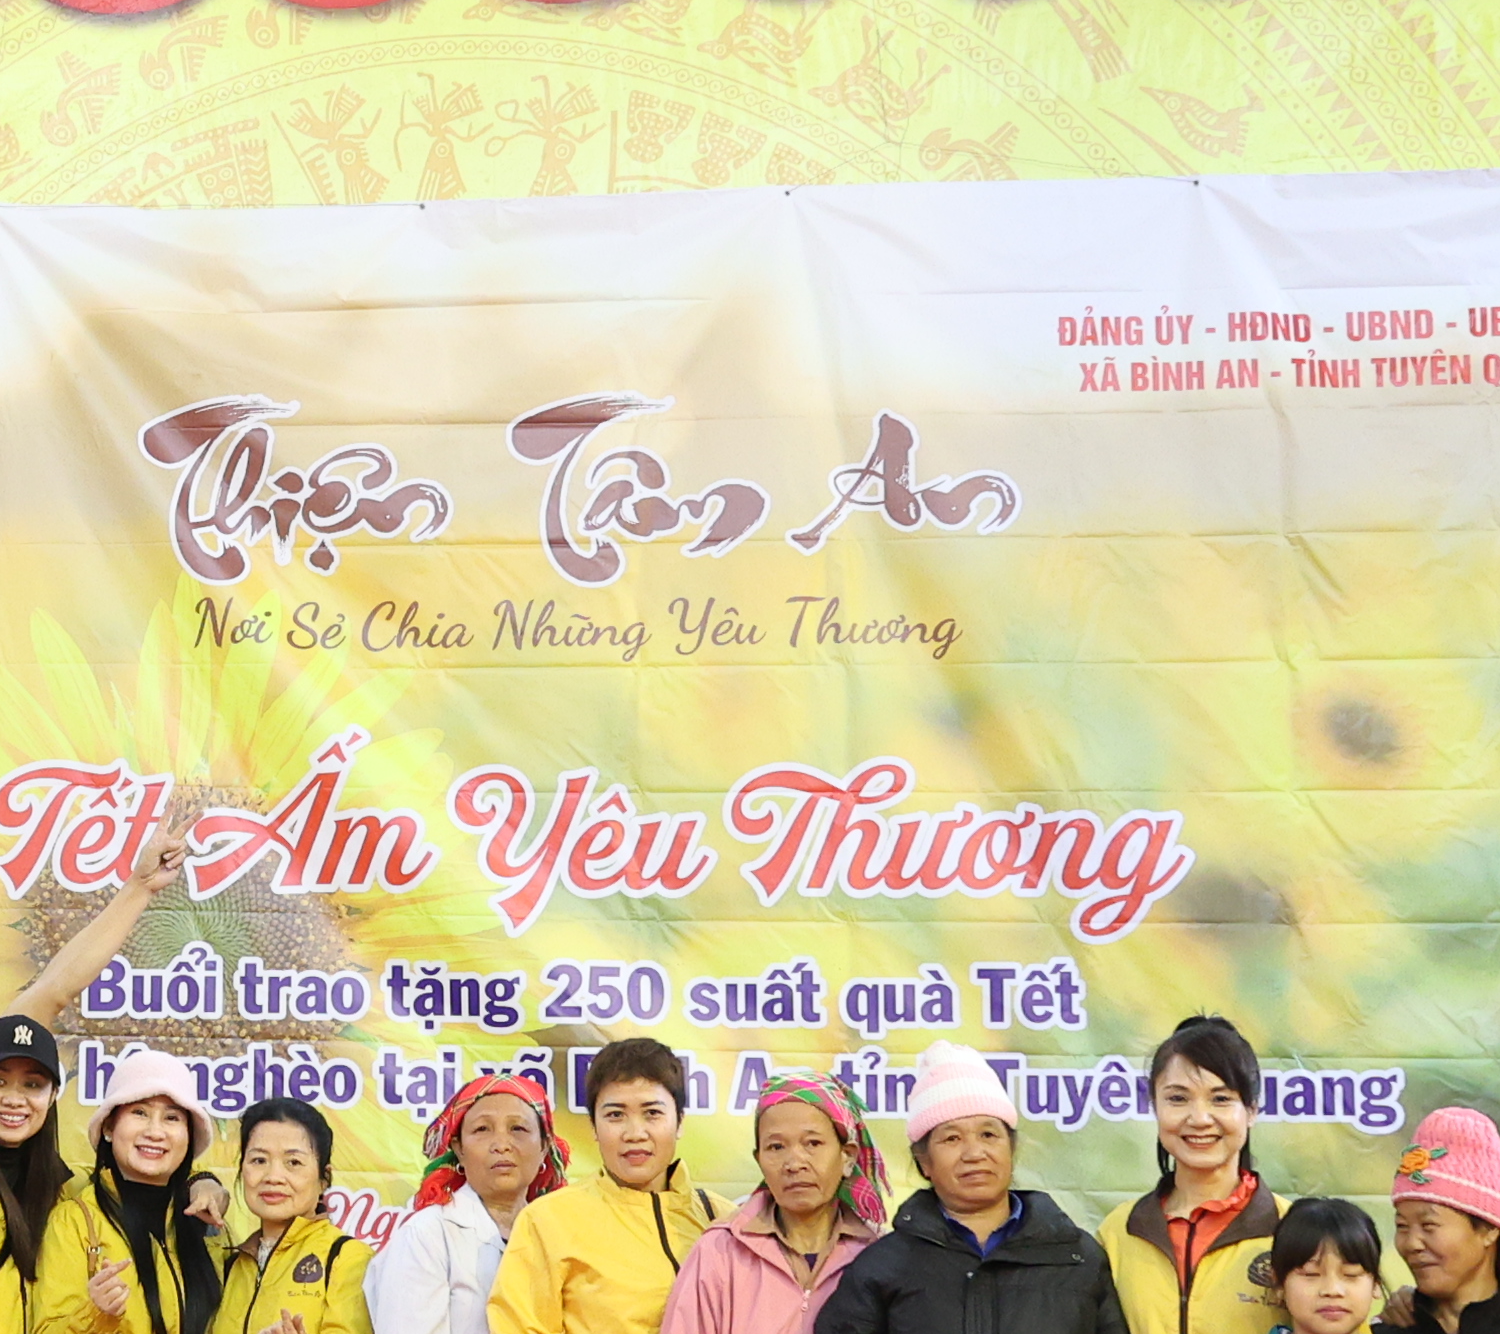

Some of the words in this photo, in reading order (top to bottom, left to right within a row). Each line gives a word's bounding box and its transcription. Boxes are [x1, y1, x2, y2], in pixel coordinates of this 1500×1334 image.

[1058, 307, 1143, 346] ĐẢNG
[1155, 307, 1193, 345] ỦY
[1228, 311, 1311, 343] HĐND
[1346, 308, 1434, 341] UBND
[1079, 357, 1120, 392] XÃ
[1131, 357, 1201, 391] BÌNH
[1216, 358, 1259, 389] AN
[1291, 350, 1360, 388] TỈNH
[1370, 350, 1471, 387] TUYÊN
[139, 393, 450, 586] Thiện
[507, 392, 770, 586] Tâm
[786, 408, 1021, 553] An
[194, 596, 274, 651] Nơi
[360, 596, 474, 652] Chia
[492, 598, 651, 660] Những
[668, 596, 766, 656] Yêu
[784, 594, 963, 660] Thương
[192, 731, 433, 893] Ấm
[451, 769, 714, 930] Yêu
[727, 762, 1192, 940] Thương
[90, 946, 223, 1014] Buổi
[239, 965, 367, 1016] trao
[388, 964, 520, 1031] tặng
[544, 967, 664, 1020] 250
[689, 962, 821, 1023] suất
[845, 967, 954, 1033] quà
[978, 960, 1081, 1025] Tết
[379, 1051, 454, 1117] tại
[837, 1052, 913, 1113] tỉn
[1254, 1075, 1397, 1127] uang
